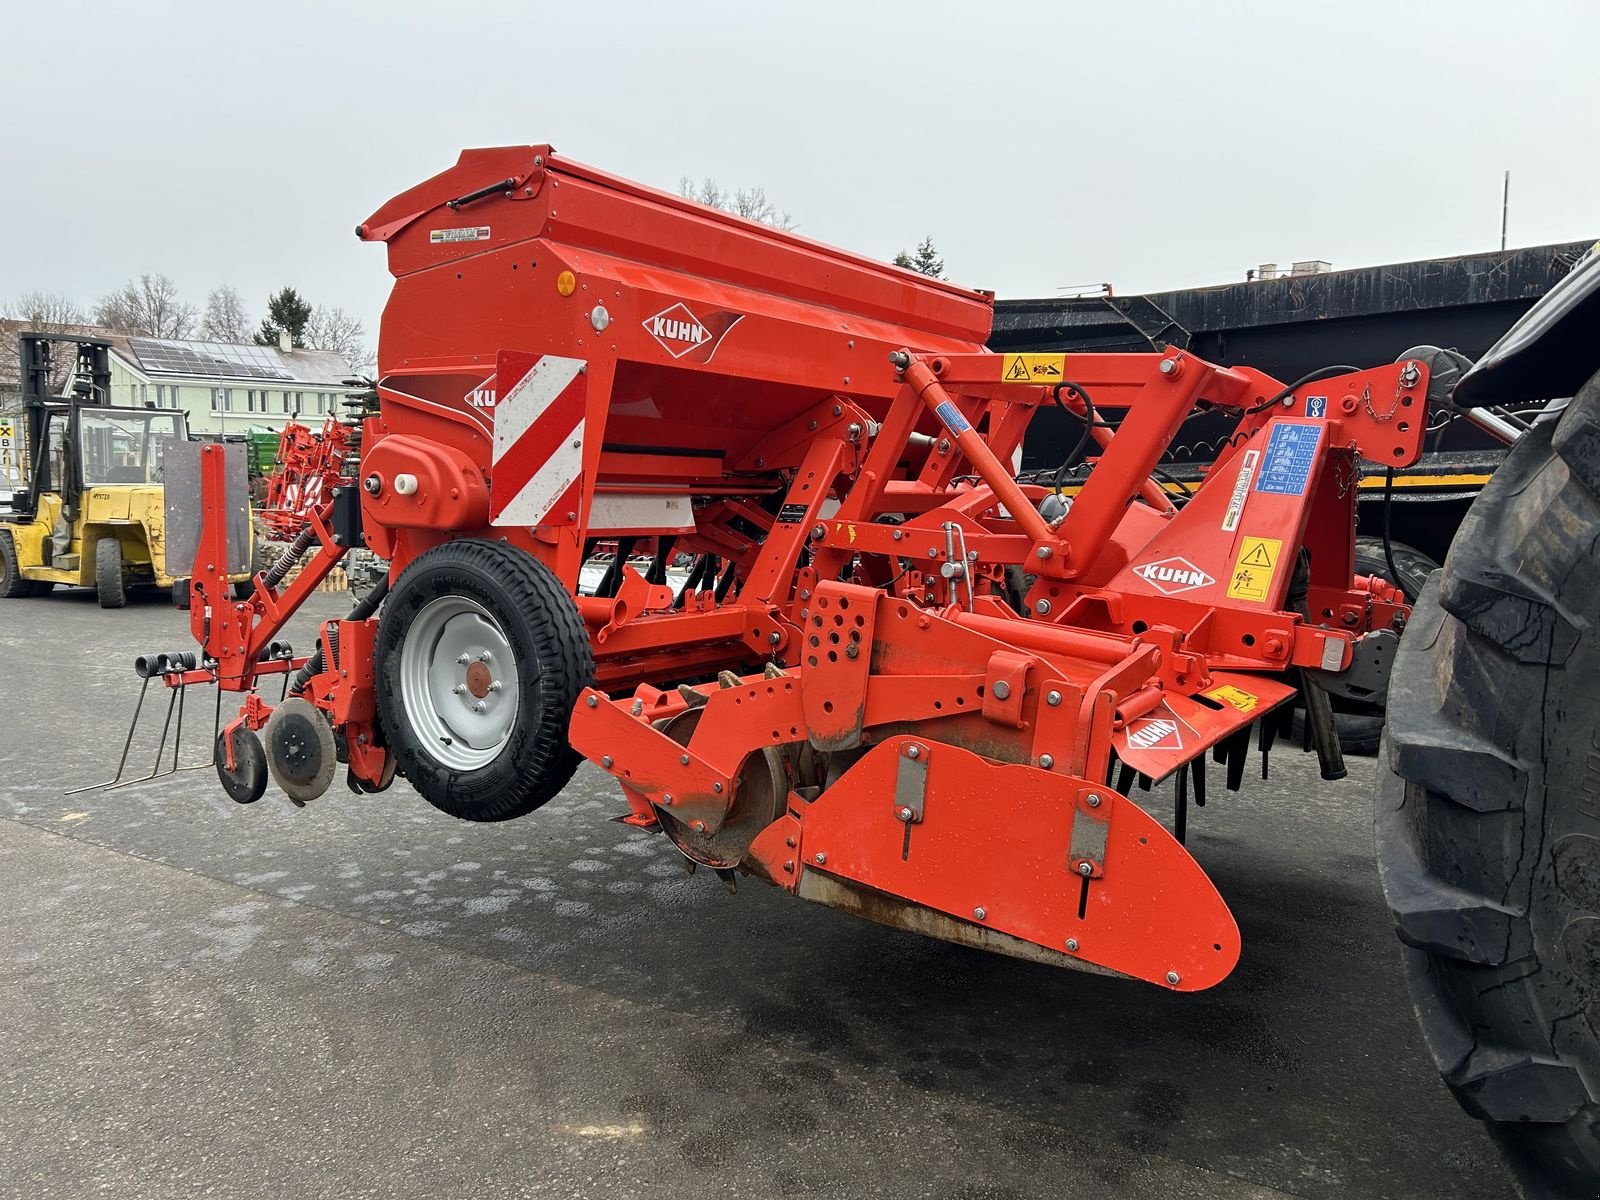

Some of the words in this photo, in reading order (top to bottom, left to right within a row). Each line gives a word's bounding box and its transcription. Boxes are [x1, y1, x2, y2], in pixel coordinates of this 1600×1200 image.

[653, 316, 703, 344] KUHN
[473, 390, 496, 407] KU
[1143, 565, 1205, 586] KUHN
[1129, 720, 1176, 748] KUHN
